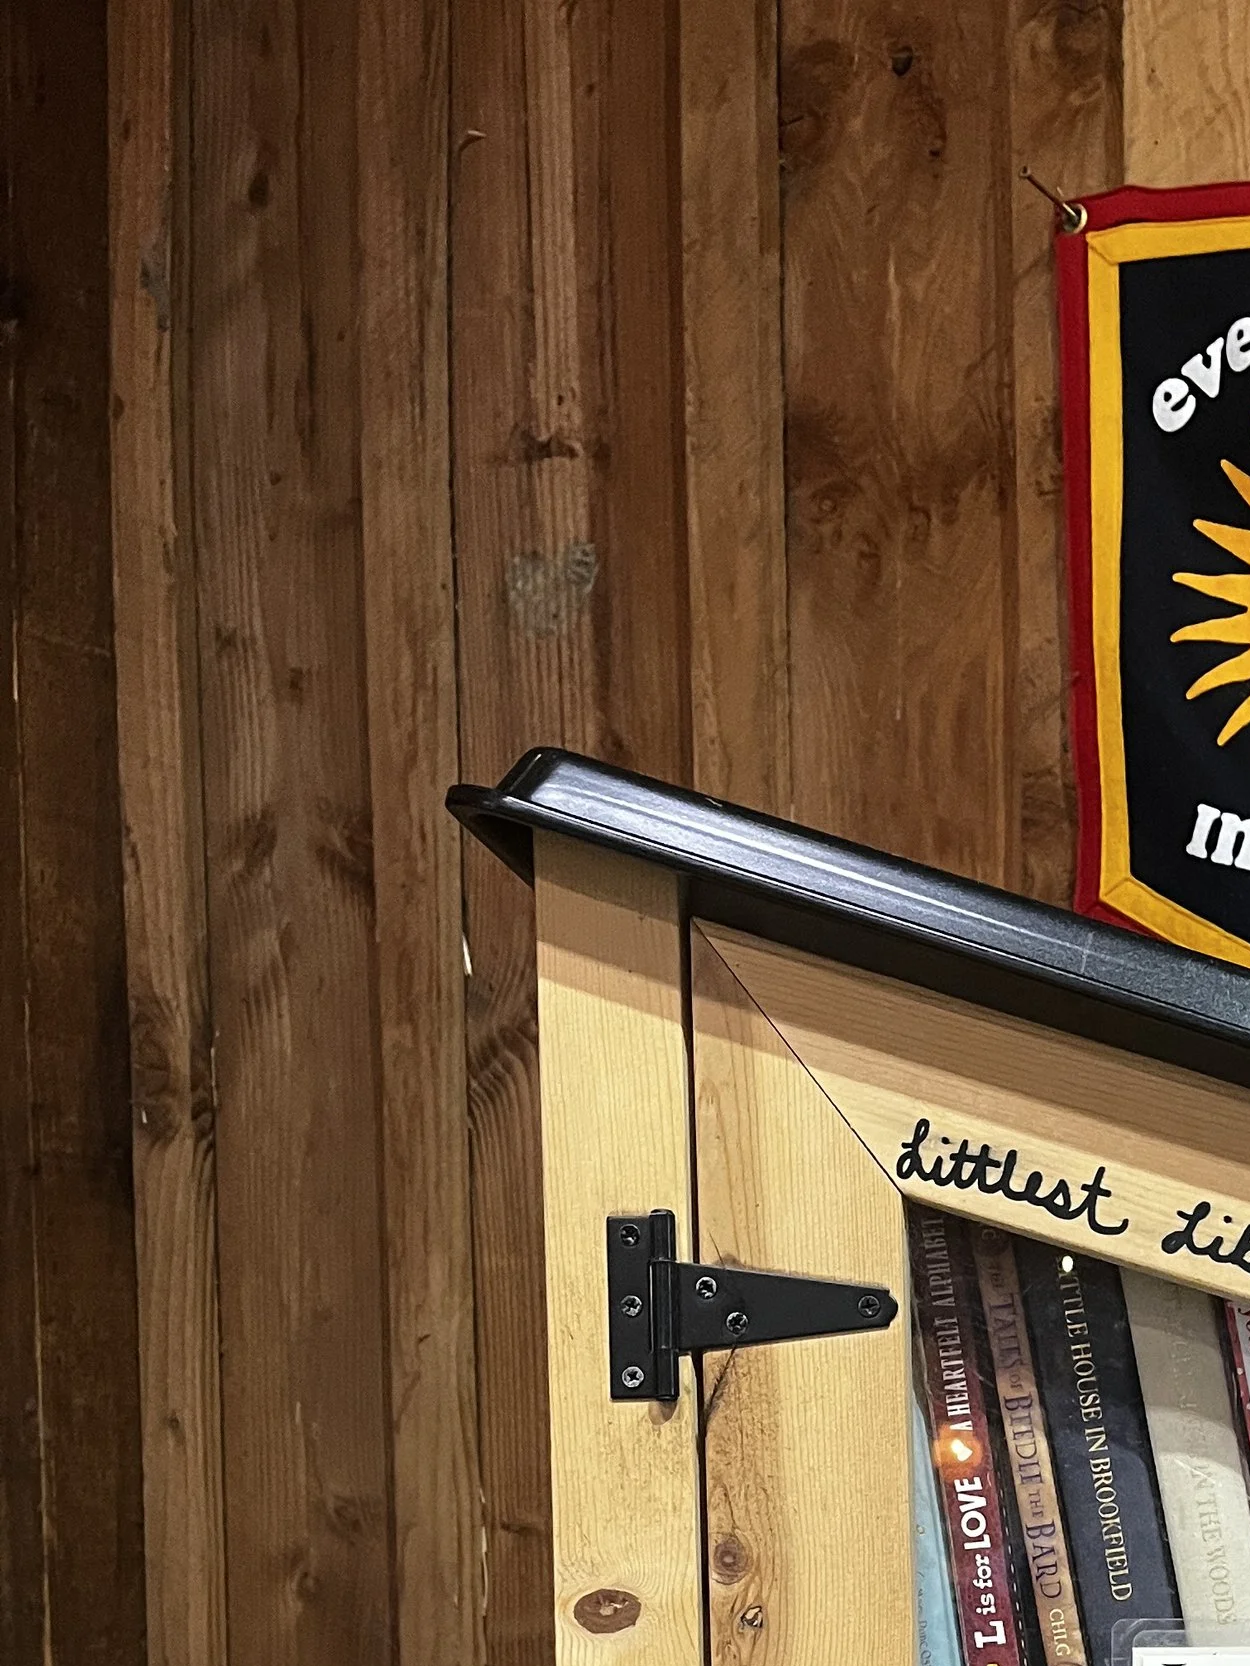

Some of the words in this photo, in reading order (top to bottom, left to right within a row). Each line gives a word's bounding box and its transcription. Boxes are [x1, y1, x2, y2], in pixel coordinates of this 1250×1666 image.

[897, 1118, 1129, 1235] Littlest
[921, 1217, 956, 1307] ALPHABET
[934, 1317, 971, 1417] HEARTFELT
[1071, 1342, 1103, 1422] HOUSE
[950, 1421, 973, 1431] A
[1085, 1427, 1108, 1453] IN
[954, 1476, 991, 1550] LOVE
[1004, 1391, 1043, 1485] BEEDLE
[1025, 1523, 1062, 1599] BARD
[1049, 1608, 1071, 1657] CHLG
[1089, 1457, 1133, 1602] BROOKFIELD
[1197, 1499, 1217, 1545] THE
[973, 1554, 992, 1590] for
[977, 1594, 996, 1615] is
[974, 1620, 1006, 1648] L
